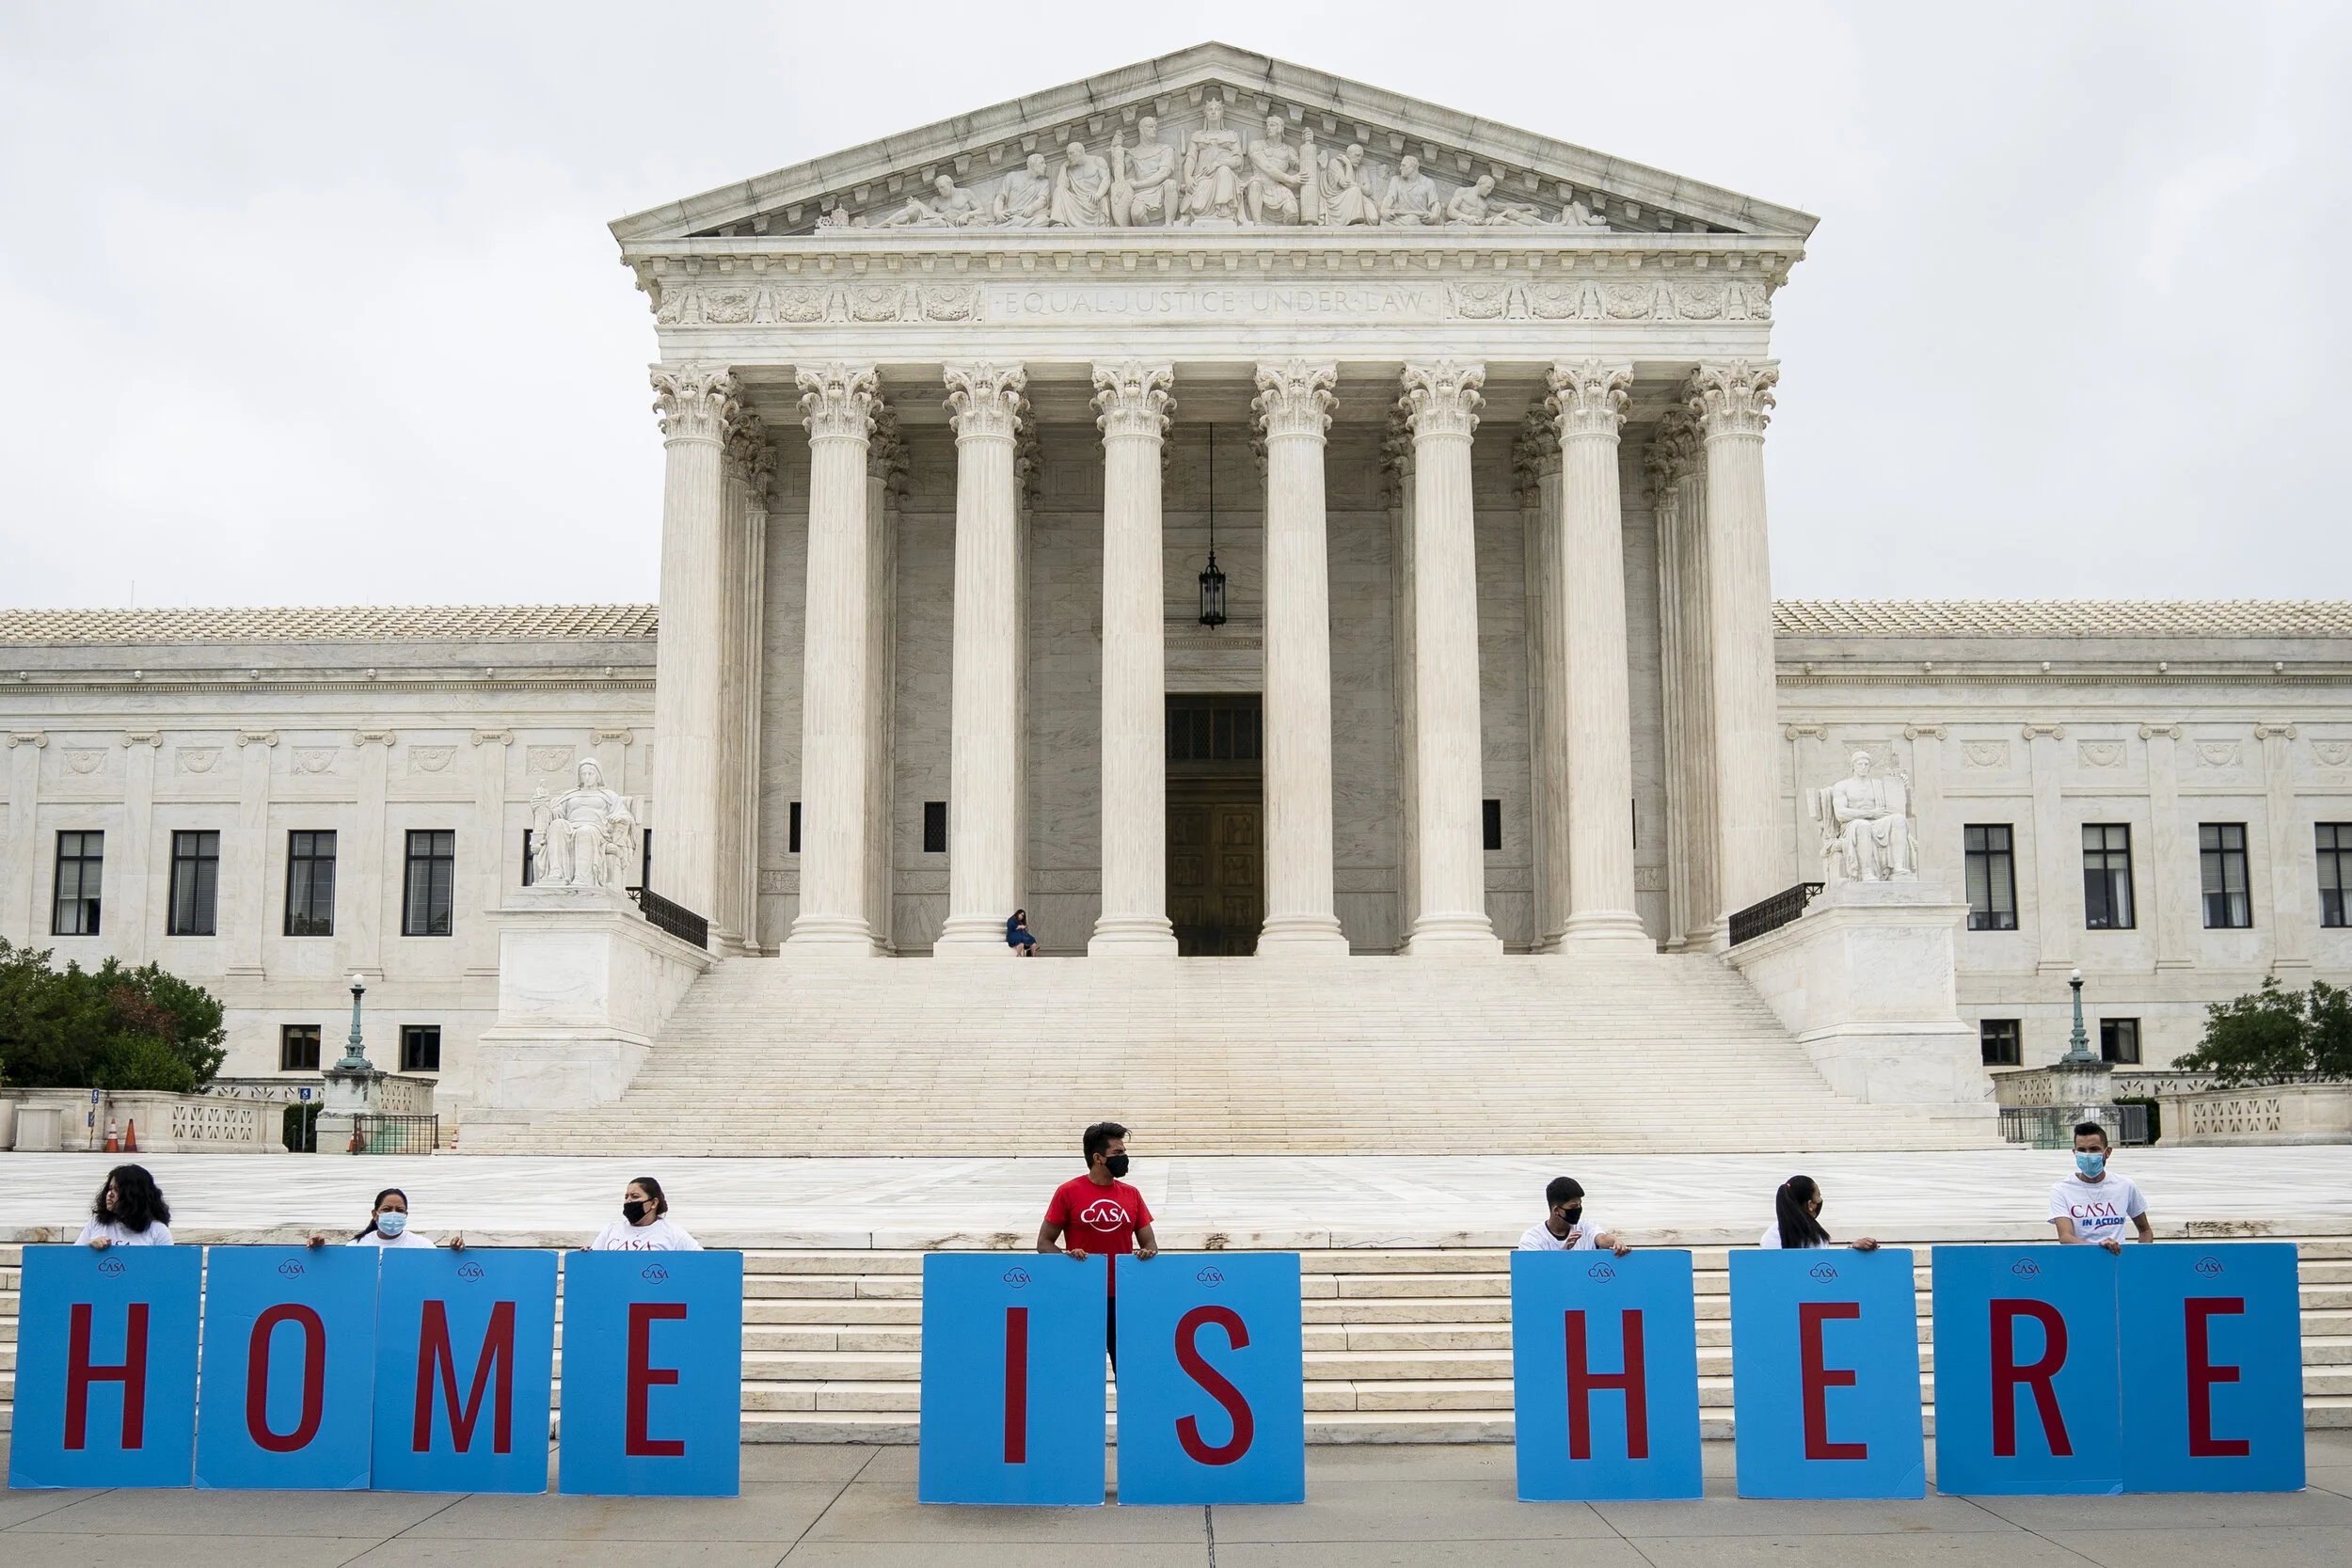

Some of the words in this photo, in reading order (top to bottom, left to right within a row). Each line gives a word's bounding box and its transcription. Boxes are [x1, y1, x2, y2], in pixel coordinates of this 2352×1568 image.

[1006, 292, 1108, 314] EQUAL
[1116, 291, 1234, 312] JUSTICE
[1250, 291, 1356, 312] UNDER
[1364, 291, 1424, 312] LAW
[2071, 1202, 2118, 1218] CASA
[1080, 1208, 1131, 1223] CASA
[2095, 1217, 2125, 1226] ACTION
[98, 1263, 125, 1272] CASA
[278, 1264, 305, 1274] CASA
[2011, 1264, 2041, 1274] CASA
[2195, 1262, 2224, 1273] CASA
[457, 1268, 485, 1277] CASA
[642, 1270, 669, 1279] CASA
[1588, 1269, 1616, 1278] CASA
[1809, 1269, 1838, 1278] CASA
[1003, 1274, 1031, 1283] CASA
[1197, 1273, 1225, 1282] CASA
